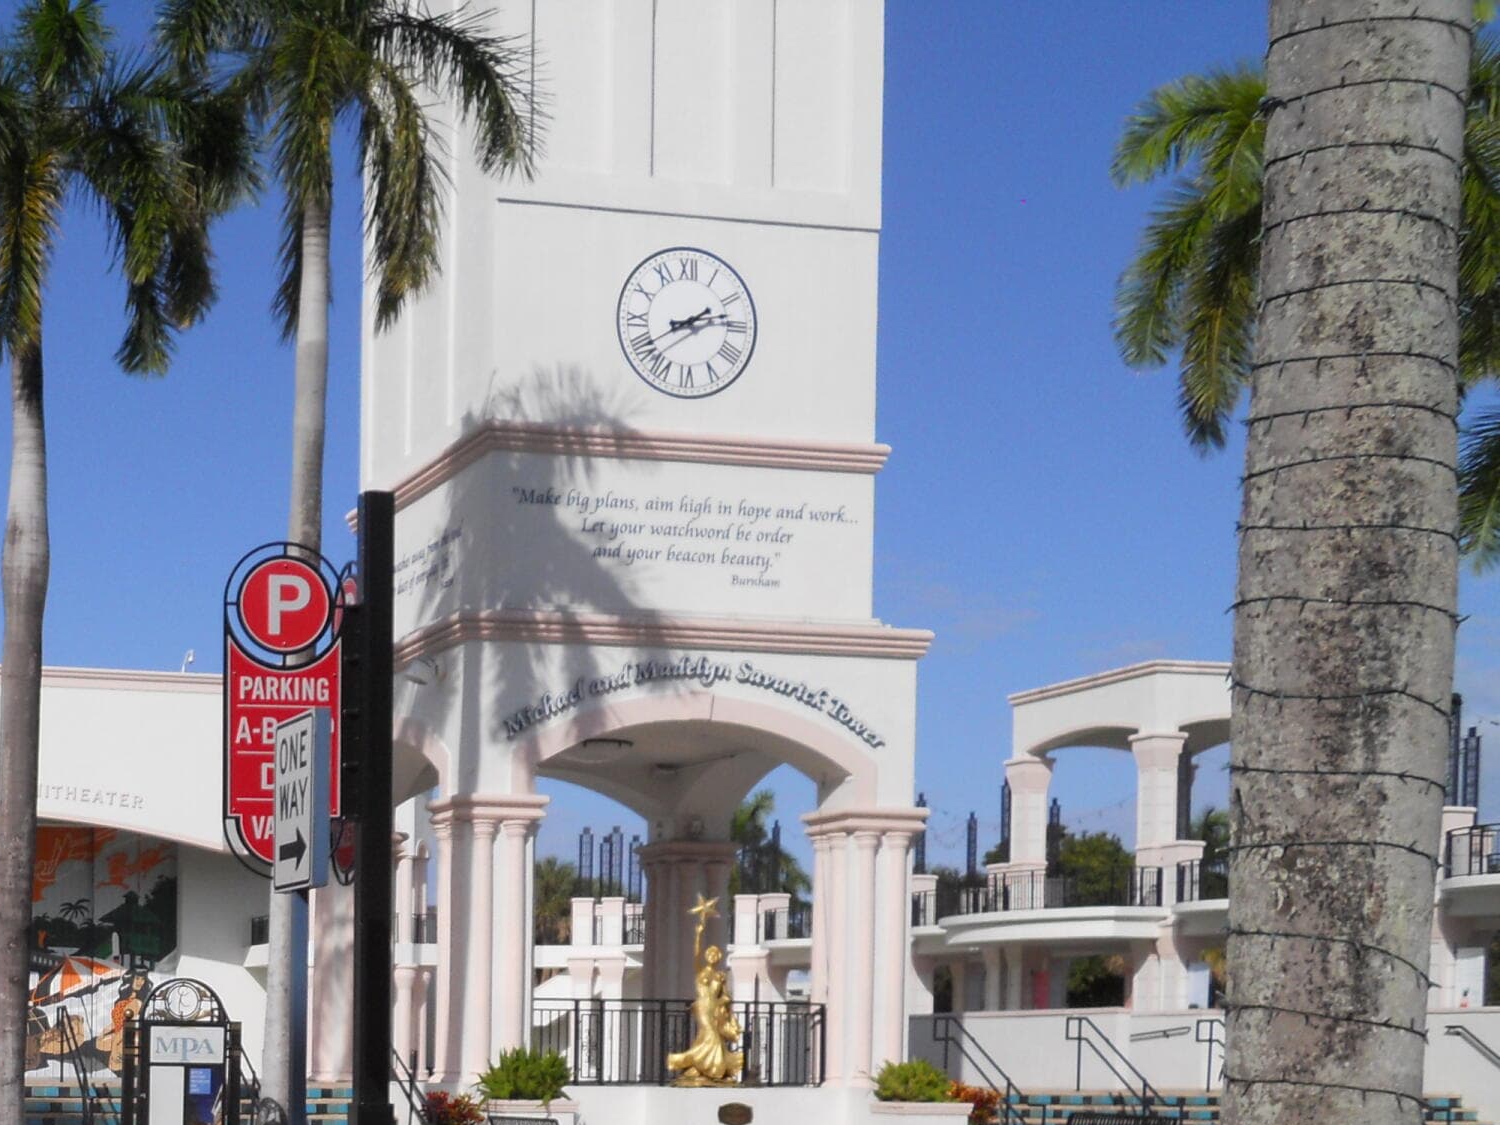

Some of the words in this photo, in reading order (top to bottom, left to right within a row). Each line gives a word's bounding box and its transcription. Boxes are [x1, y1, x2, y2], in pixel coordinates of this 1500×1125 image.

[653, 262, 674, 287] XI
[679, 258, 698, 282] XII
[634, 283, 656, 301] X
[720, 292, 740, 306] II
[679, 365, 694, 388] VI
[706, 361, 720, 383] V
[566, 489, 591, 514] big
[589, 491, 640, 515] plans,
[645, 497, 674, 512] aim
[679, 495, 712, 520] high
[718, 500, 732, 515] in
[738, 500, 772, 524] hope
[775, 503, 807, 520] and
[809, 505, 859, 524] work...
[581, 518, 605, 533] Let
[609, 521, 646, 540] your
[650, 519, 735, 540] watchword
[736, 524, 753, 542] be
[756, 527, 793, 544] order
[592, 541, 625, 559] and
[626, 548, 663, 566] your
[666, 544, 716, 564] beacon
[720, 547, 781, 573] beauty."
[731, 574, 781, 588] Burnham
[268, 573, 312, 635] P
[239, 676, 330, 702] PARKING
[503, 676, 586, 740] Michael
[589, 663, 632, 696] and
[635, 656, 731, 688] Madelyn
[827, 696, 886, 749] Tower
[280, 729, 308, 775] ONE
[280, 776, 309, 822] WAY
[155, 1035, 215, 1061] MPA
